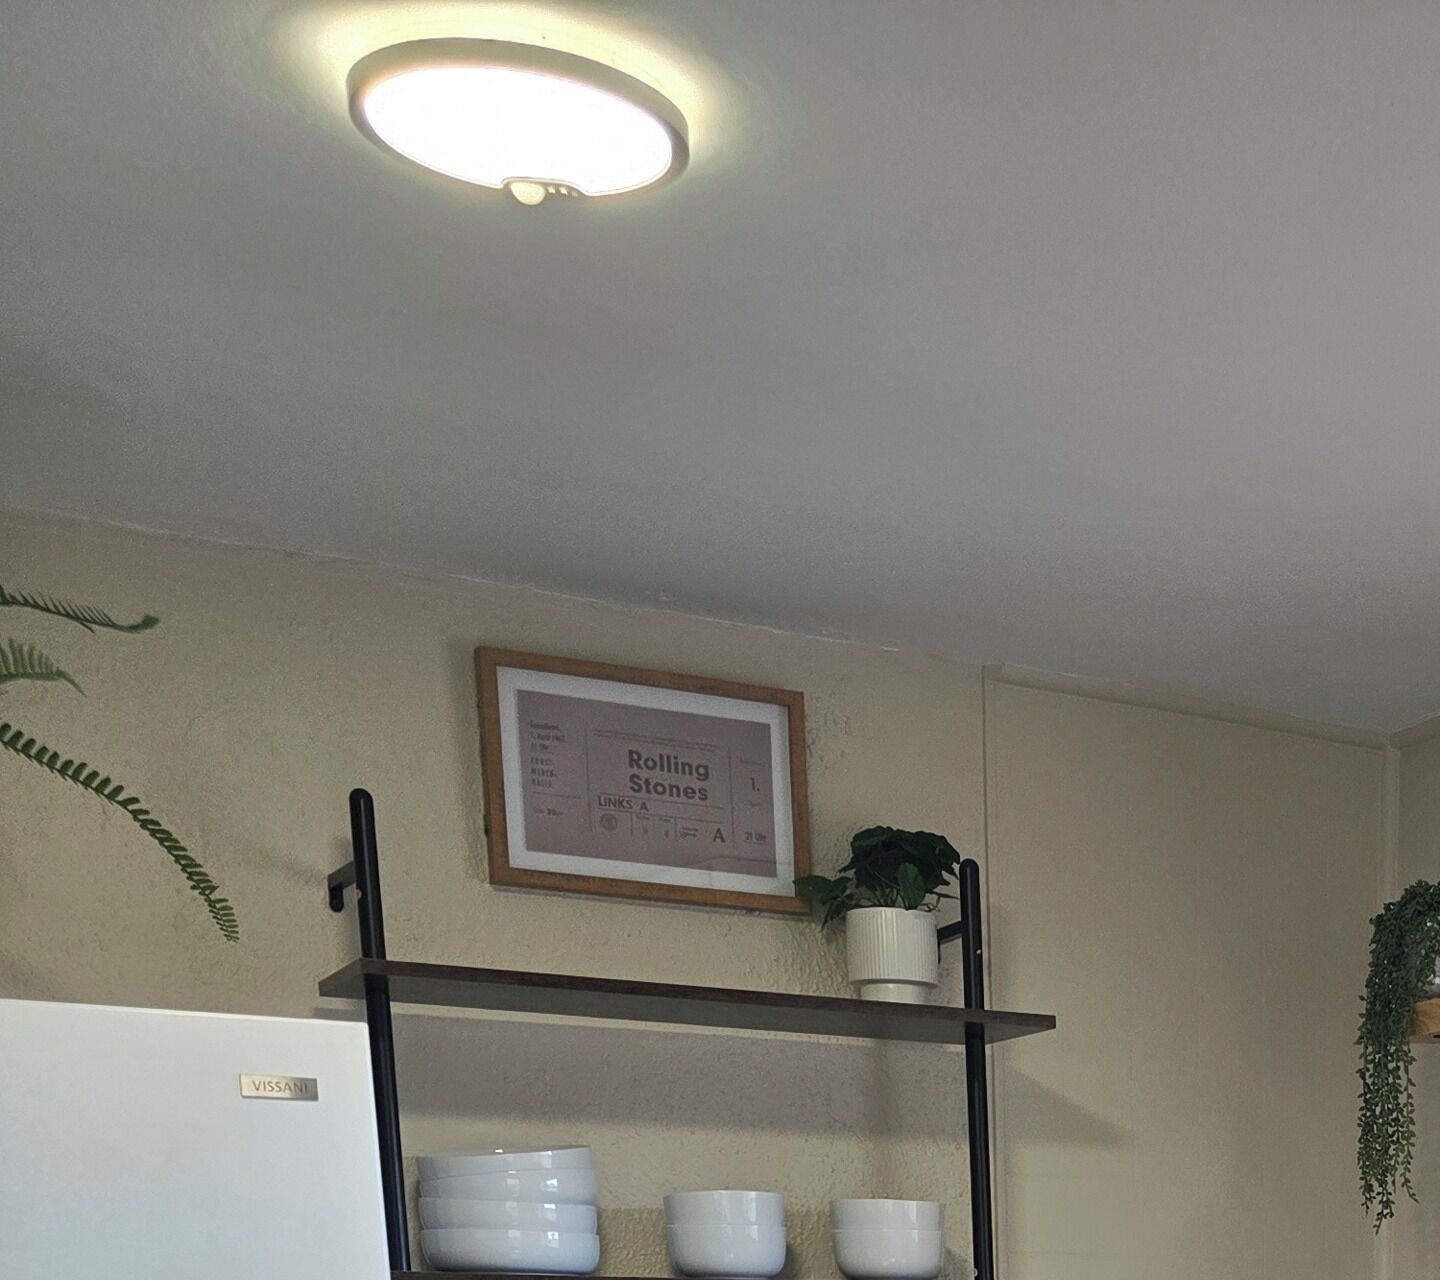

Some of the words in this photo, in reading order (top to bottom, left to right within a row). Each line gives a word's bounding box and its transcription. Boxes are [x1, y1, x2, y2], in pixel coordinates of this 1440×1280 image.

[628, 749, 710, 782] Rolling
[629, 773, 709, 801] Stones
[598, 796, 633, 810] LINKS
[639, 801, 649, 812] A
[712, 828, 726, 843] A
[251, 1079, 308, 1094] VISSANI
